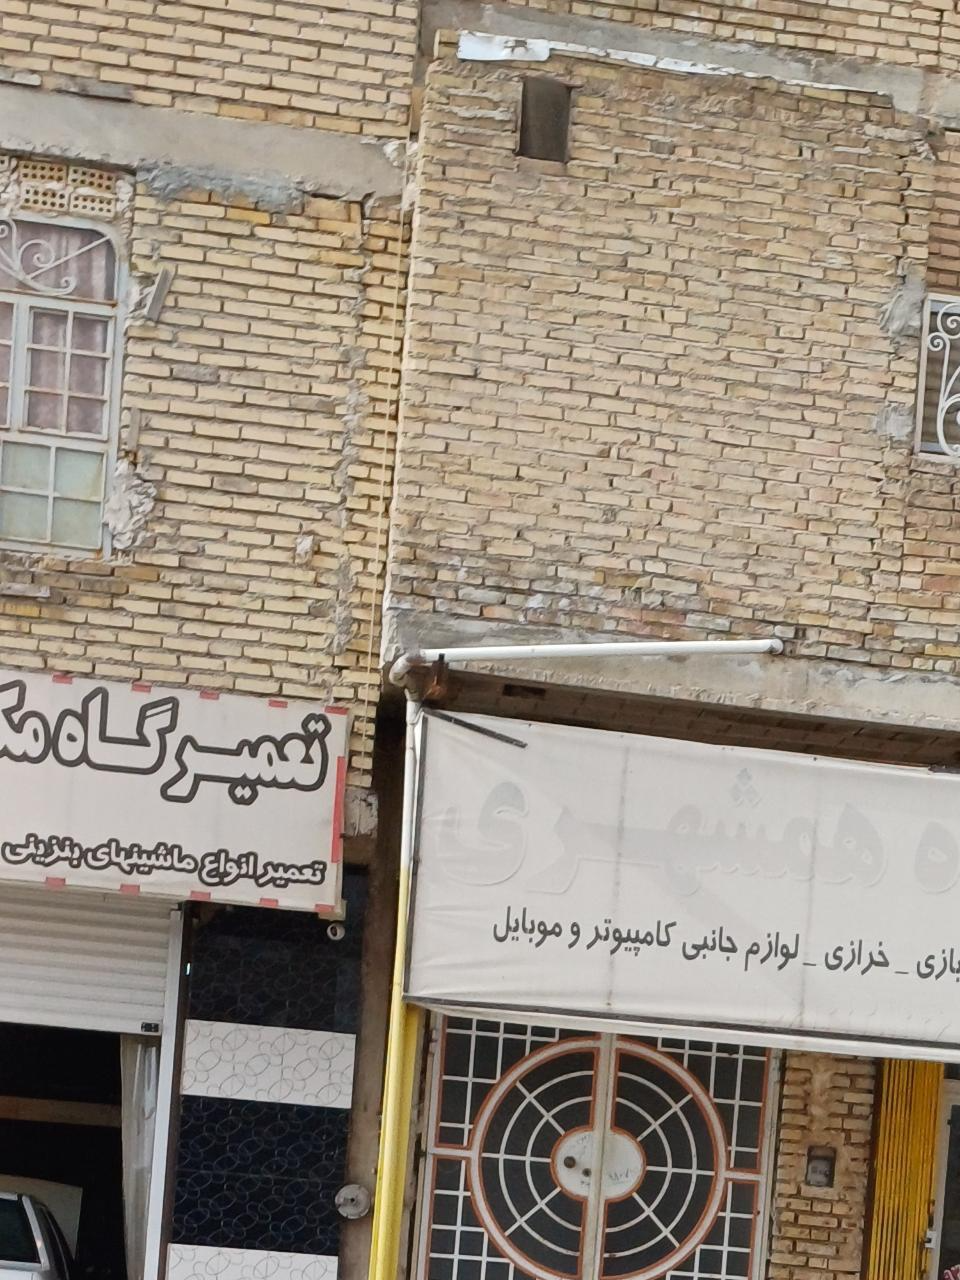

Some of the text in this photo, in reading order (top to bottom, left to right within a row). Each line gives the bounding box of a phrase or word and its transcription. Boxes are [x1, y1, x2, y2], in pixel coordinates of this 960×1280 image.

[52, 686, 332, 805] تعمیرگاه
[1, 833, 327, 888] تعمیر انواع ماشینهای بنزینی
[493, 906, 563, 949] موبایل
[568, 921, 581, 949] و
[586, 917, 677, 957] کامپیوتر
[682, 926, 739, 962] جانبی
[745, 933, 800, 971] لوازم
[824, 940, 890, 975] خرازی
